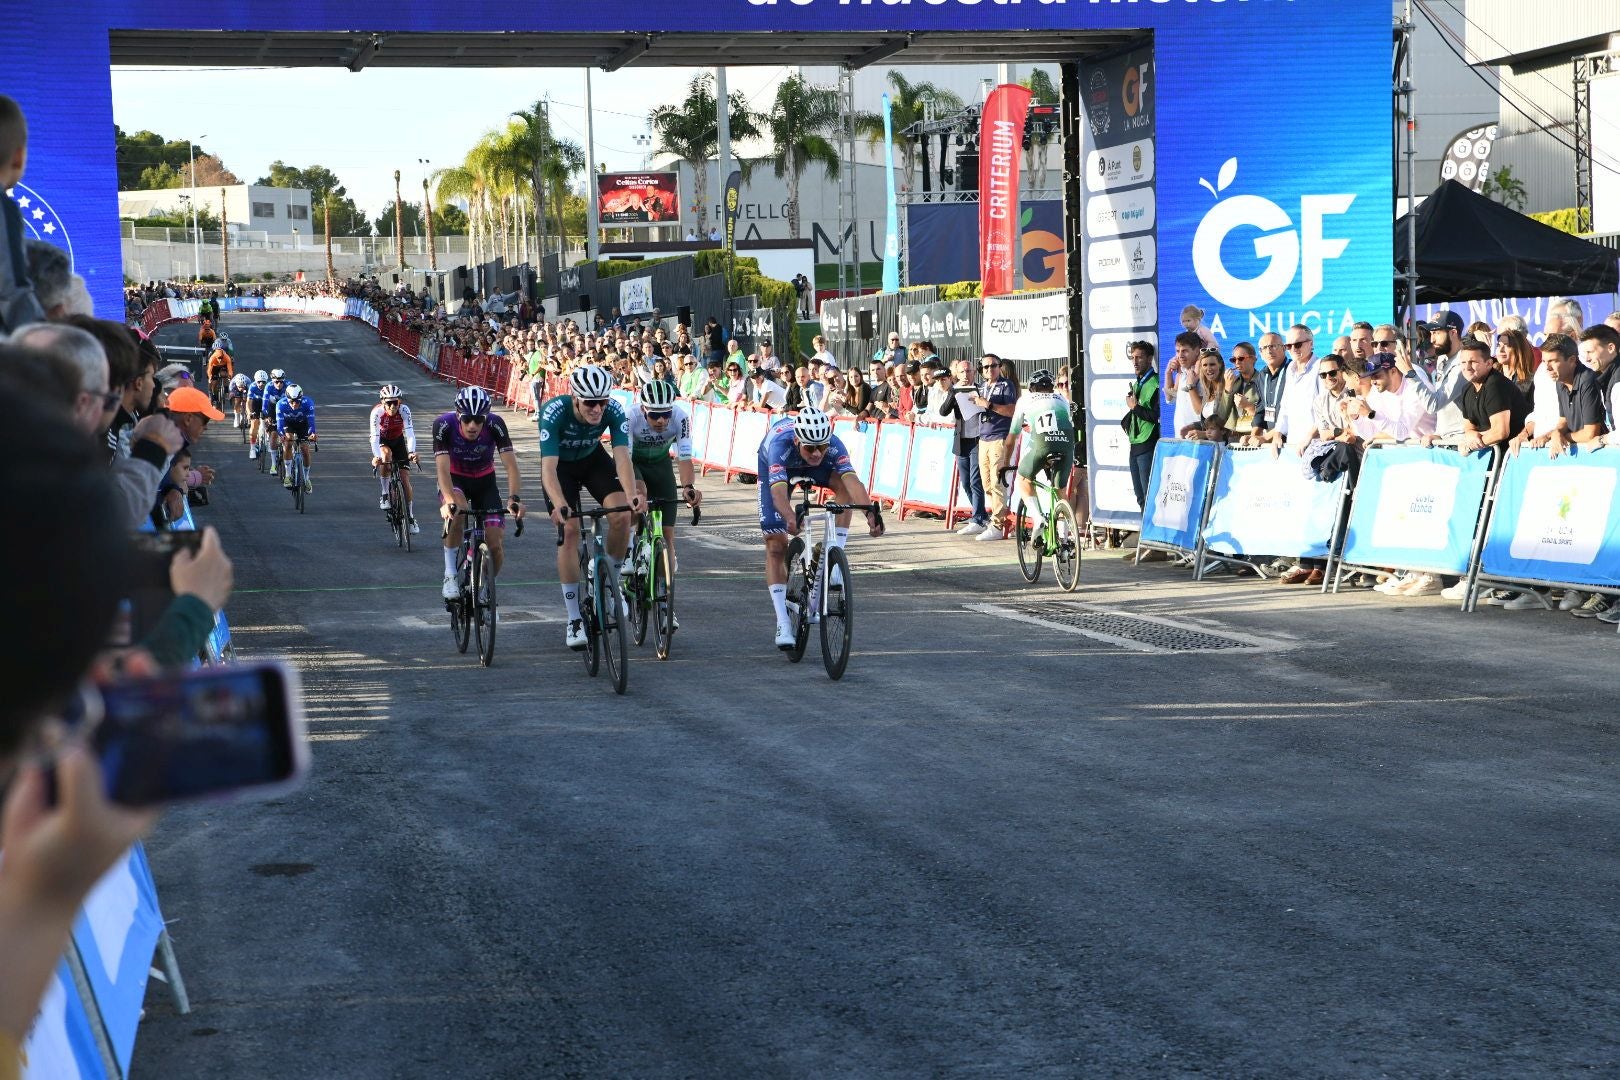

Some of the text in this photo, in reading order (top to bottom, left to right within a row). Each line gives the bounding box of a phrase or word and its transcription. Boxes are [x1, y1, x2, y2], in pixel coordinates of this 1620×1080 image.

[989, 120, 1015, 220] CRITERIUM
[1192, 193, 1357, 309] GF
[542, 399, 564, 421] KERN
[1037, 412, 1053, 428] 17
